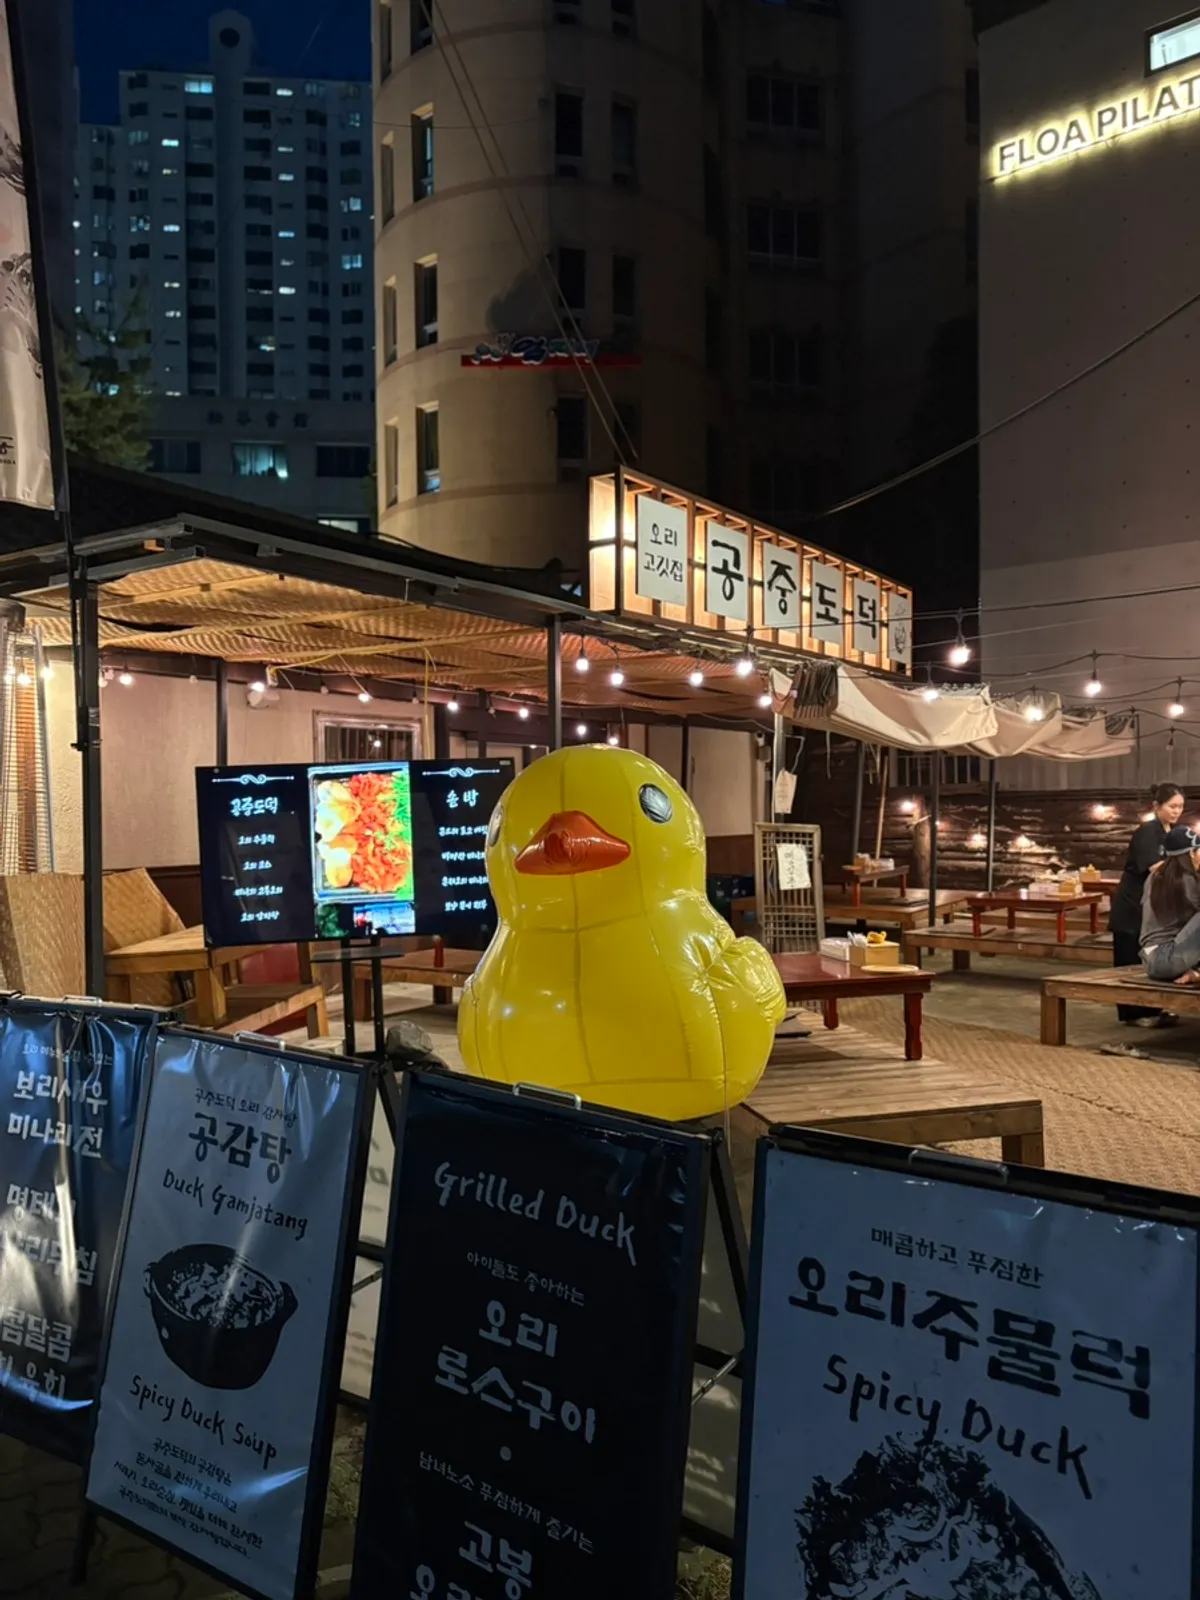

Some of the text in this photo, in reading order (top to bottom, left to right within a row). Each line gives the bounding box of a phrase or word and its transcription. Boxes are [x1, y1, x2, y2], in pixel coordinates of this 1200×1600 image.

[998, 74, 1200, 172] FLOA PILAT
[643, 552, 683, 582] 고깃집
[649, 523, 678, 547] 오리
[711, 539, 877, 640] 공중도덕
[230, 797, 279, 817] 공중도덕
[13, 1070, 108, 1114] 보리새우
[239, 1099, 260, 1113] 오리
[188, 1112, 292, 1184] 공감탕
[162, 1168, 308, 1242] Duck Gamjatang
[434, 1161, 638, 1268] Grilled Duck
[466, 1252, 585, 1307] 아이들도 좋아하는
[870, 1227, 1045, 1290] 매콤하고 푸짐한
[478, 1299, 559, 1358] 오리
[788, 1256, 1151, 1420] 오리주물럭
[129, 1374, 175, 1422] Spicy
[181, 1397, 225, 1446] Duck
[434, 1343, 597, 1444] 로스구이
[822, 1354, 1092, 1501] Spicy Duck
[418, 1449, 596, 1555] 남녀노소 푸짐하게 즐기는
[458, 1519, 534, 1600] 고봉
